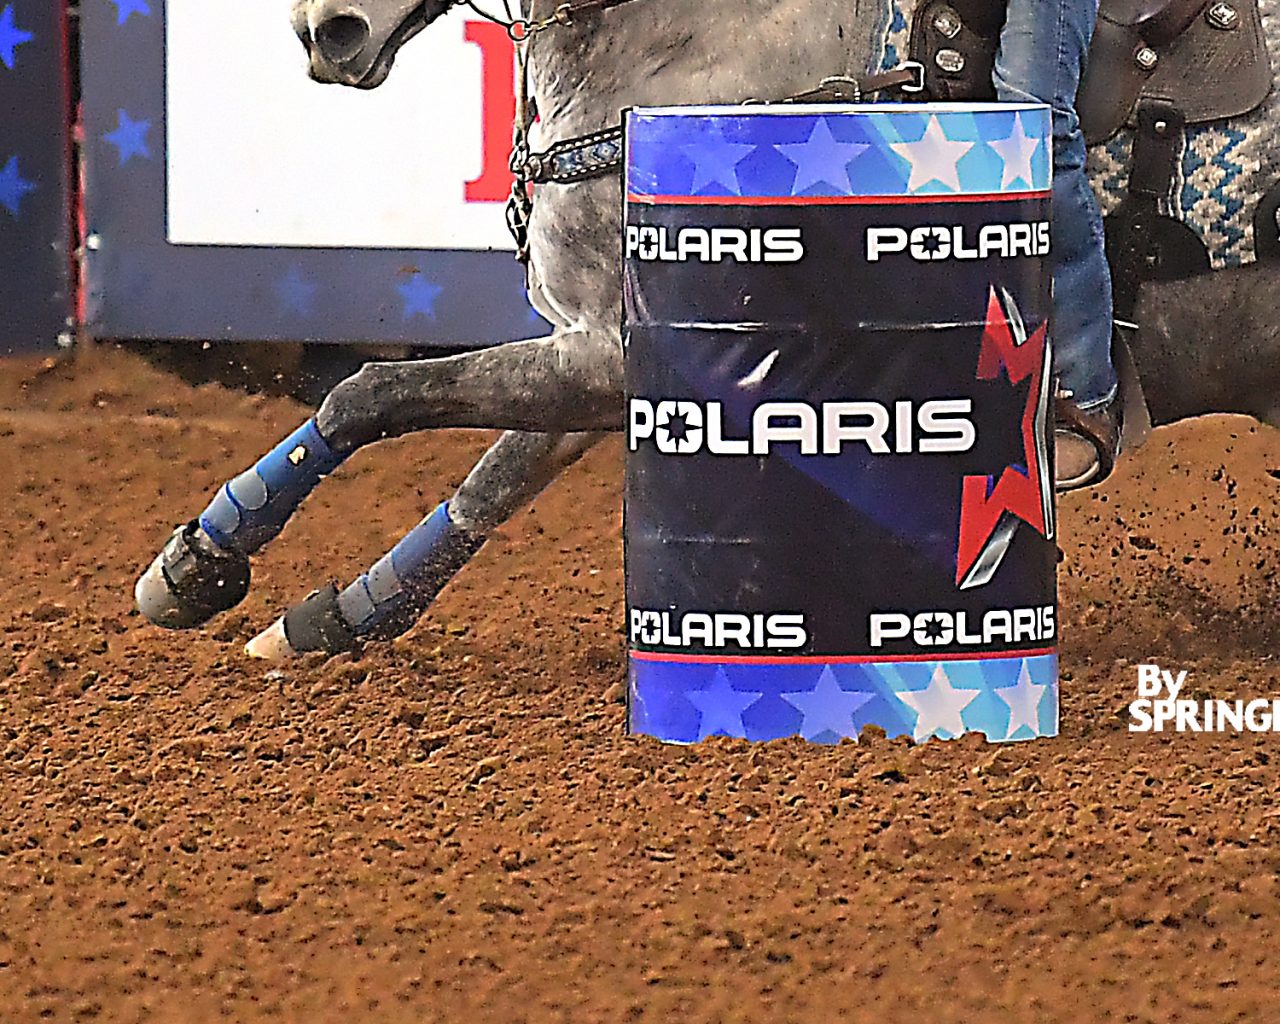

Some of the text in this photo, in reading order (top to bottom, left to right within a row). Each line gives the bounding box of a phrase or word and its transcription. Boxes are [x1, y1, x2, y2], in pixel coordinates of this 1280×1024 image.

[625, 225, 805, 263] POLARIS
[866, 221, 1050, 262] POLARIS
[629, 398, 976, 456] POLARIS
[629, 607, 806, 649] POLARIS
[869, 604, 1056, 647] POLARIS
